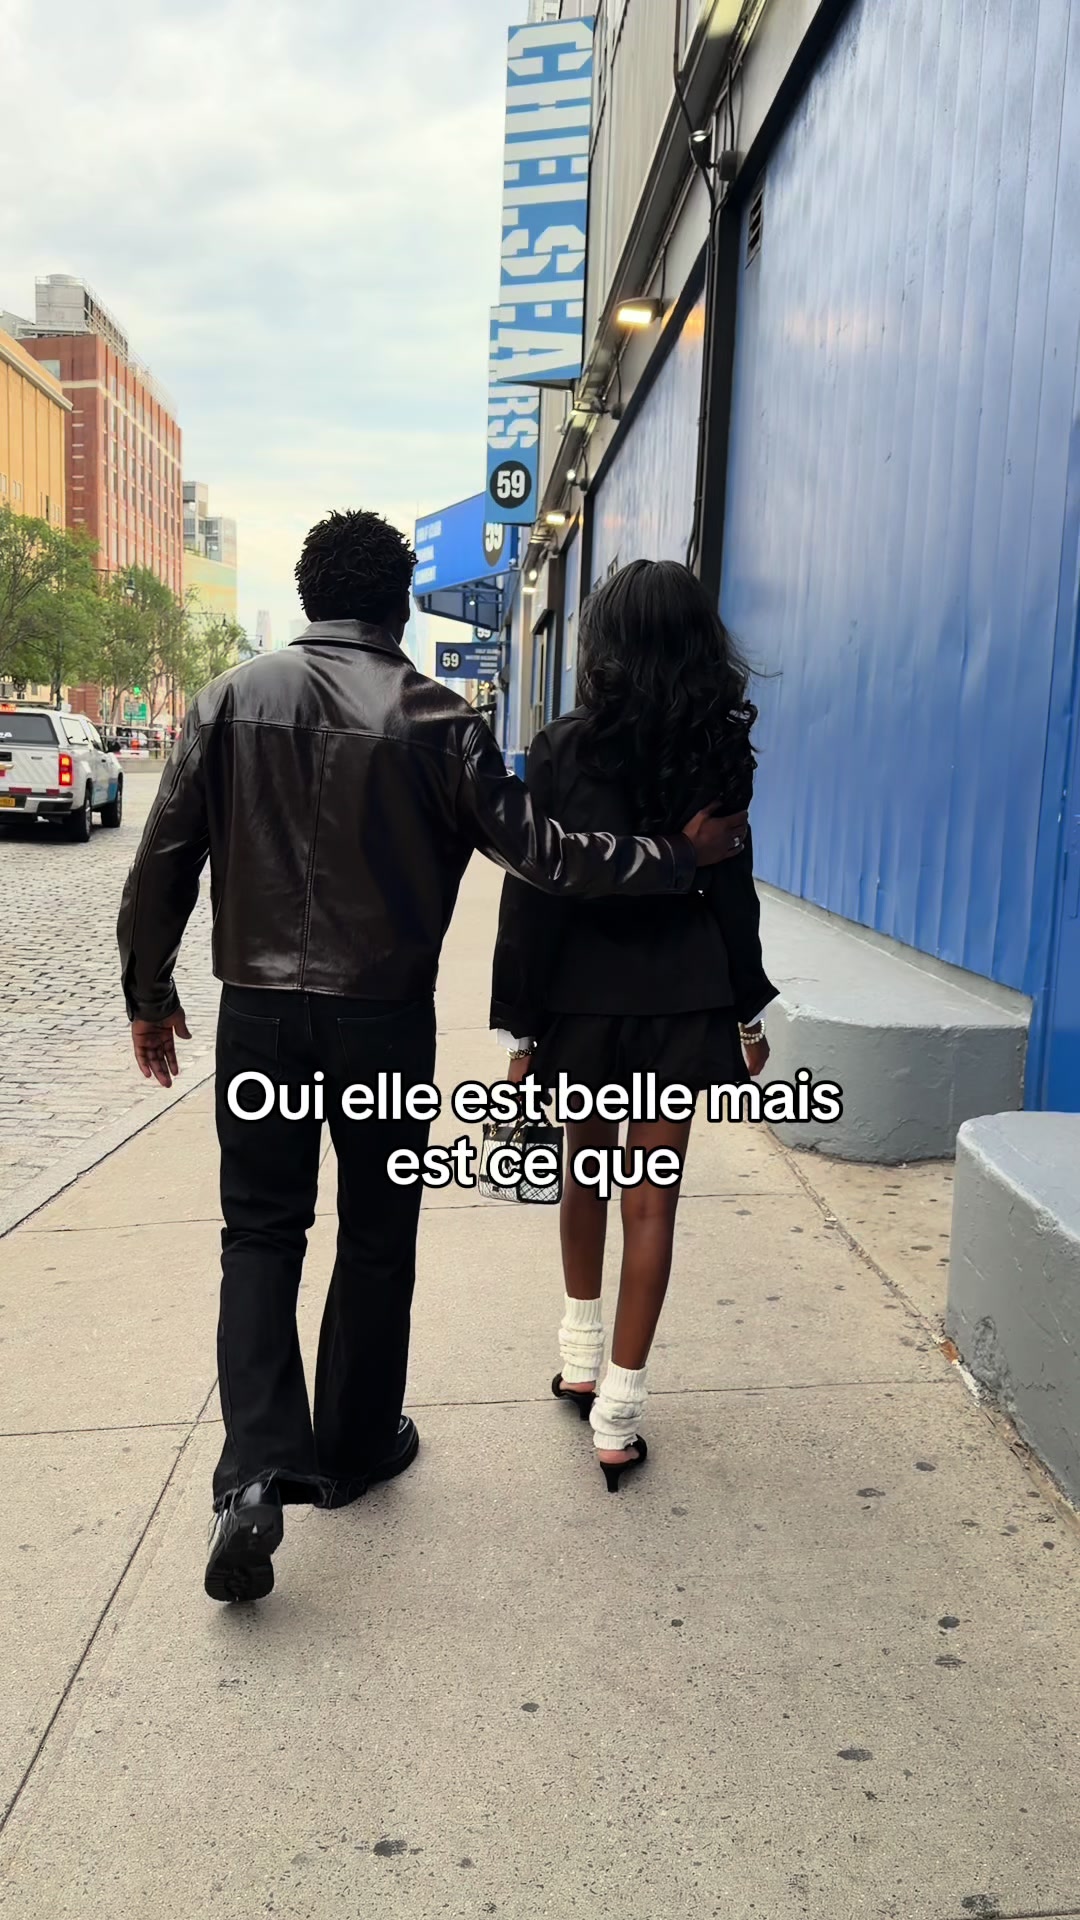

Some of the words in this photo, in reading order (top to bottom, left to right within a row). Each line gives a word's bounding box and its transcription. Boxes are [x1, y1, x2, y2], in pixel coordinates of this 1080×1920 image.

[497, 21, 594, 380] CHELSEA
[496, 469, 526, 499] 59
[441, 652, 460, 668] 59
